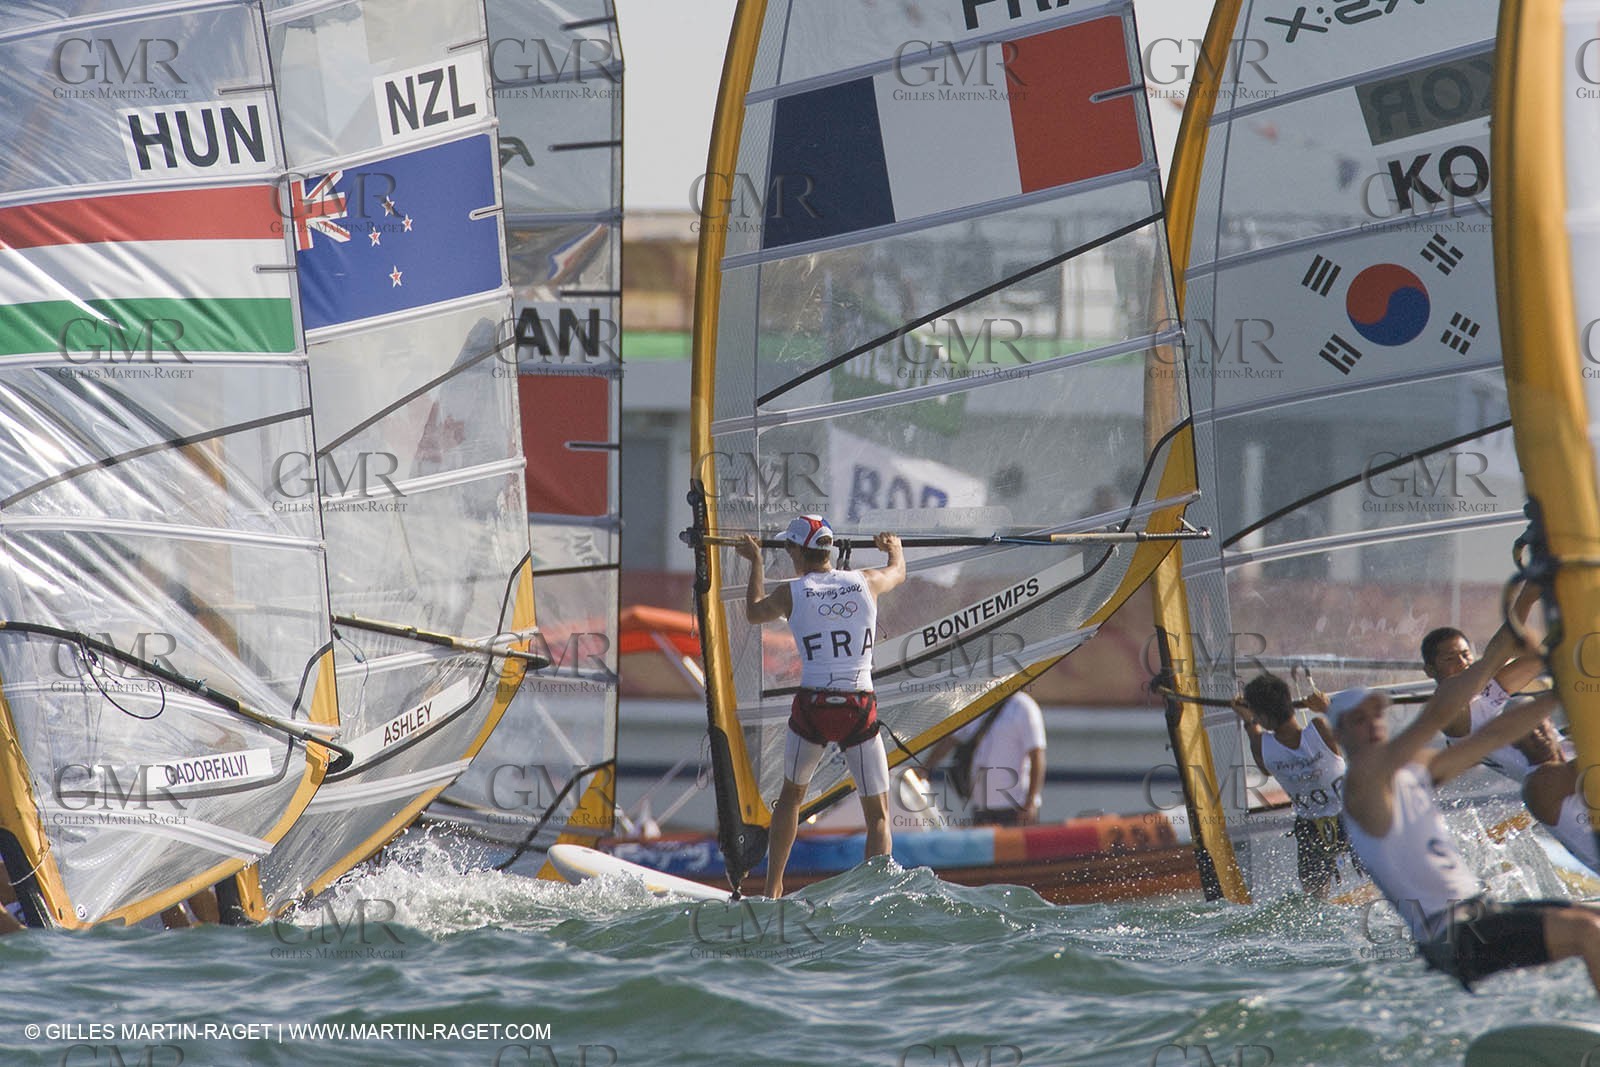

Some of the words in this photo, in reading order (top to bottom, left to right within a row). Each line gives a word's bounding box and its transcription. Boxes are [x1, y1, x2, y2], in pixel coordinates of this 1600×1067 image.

[385, 65, 476, 136] NZL
[128, 105, 266, 170] HUN
[922, 578, 1040, 648] BONTEMPS
[802, 627, 873, 661] FRA
[383, 702, 432, 746] ASHLEY
[165, 755, 249, 786] GADORFALVI
